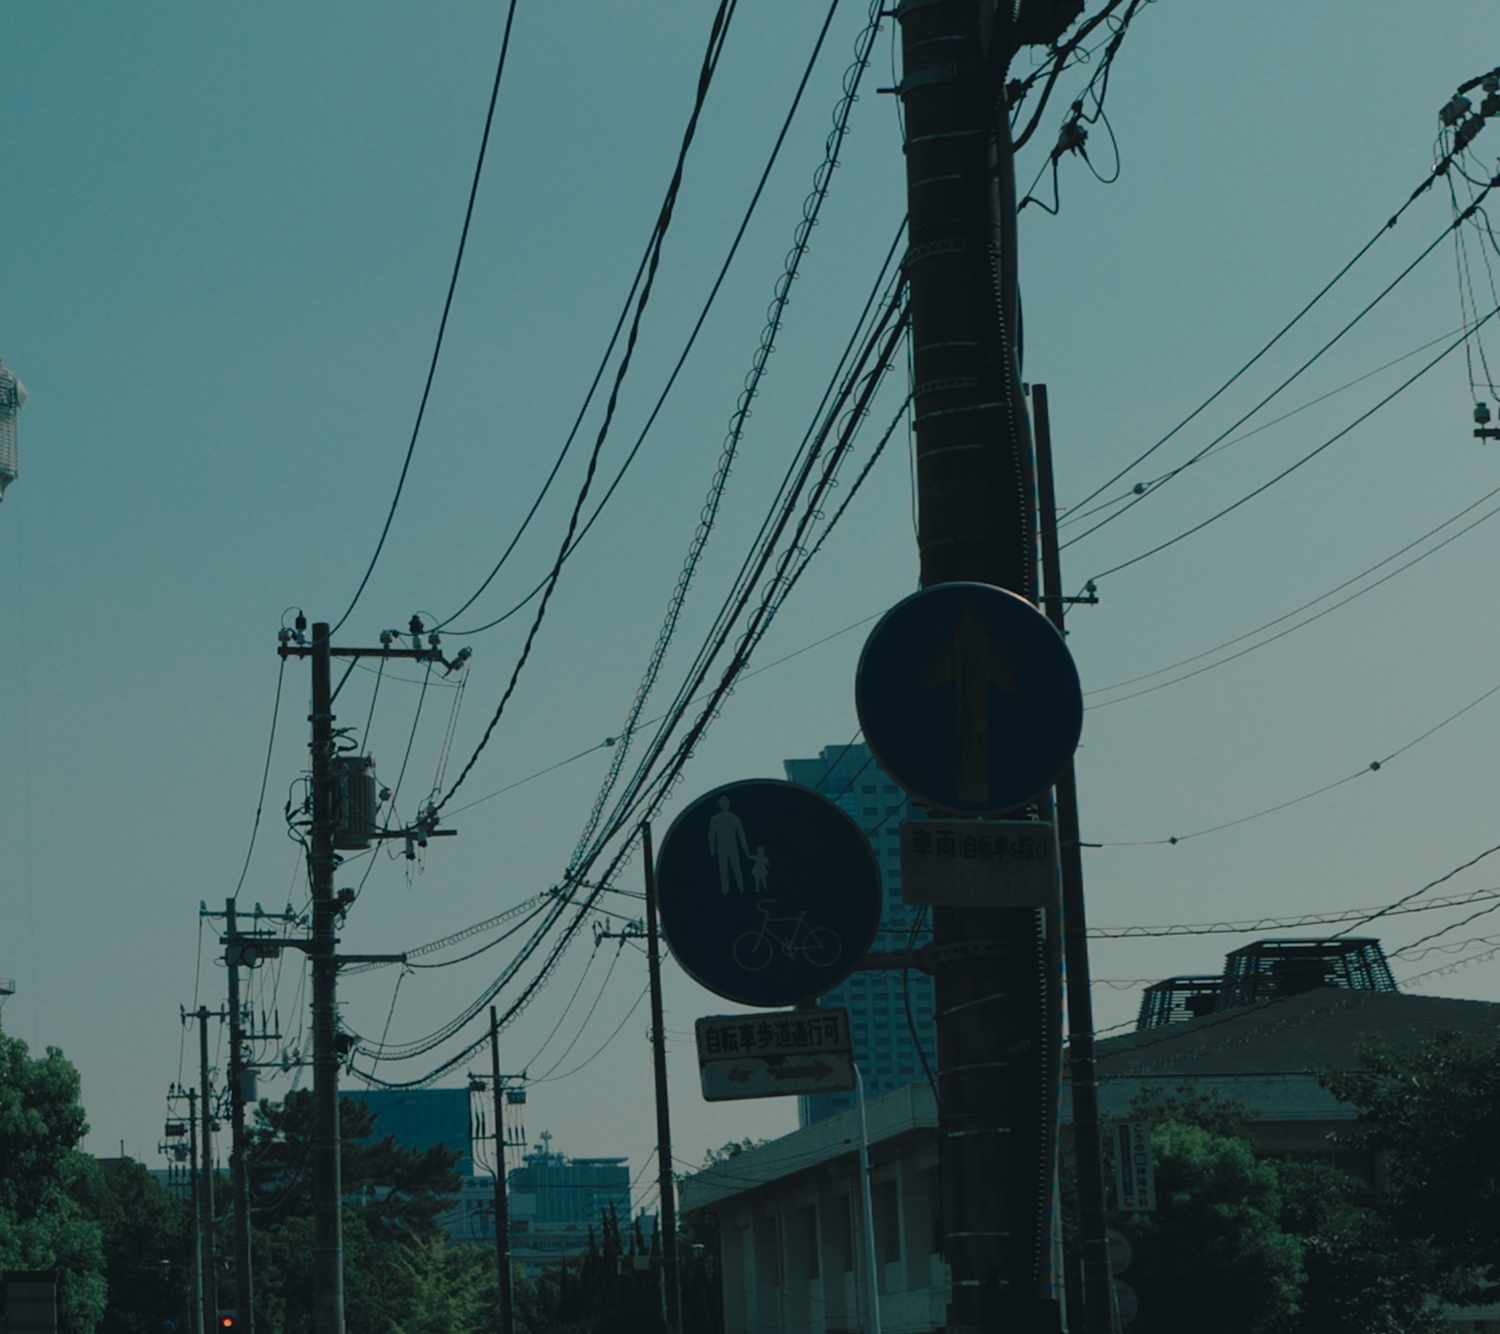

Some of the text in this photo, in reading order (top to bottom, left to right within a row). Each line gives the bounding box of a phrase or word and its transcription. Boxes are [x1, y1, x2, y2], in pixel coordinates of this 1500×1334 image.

[706, 1017, 839, 1054] 自転車歩道通行可
